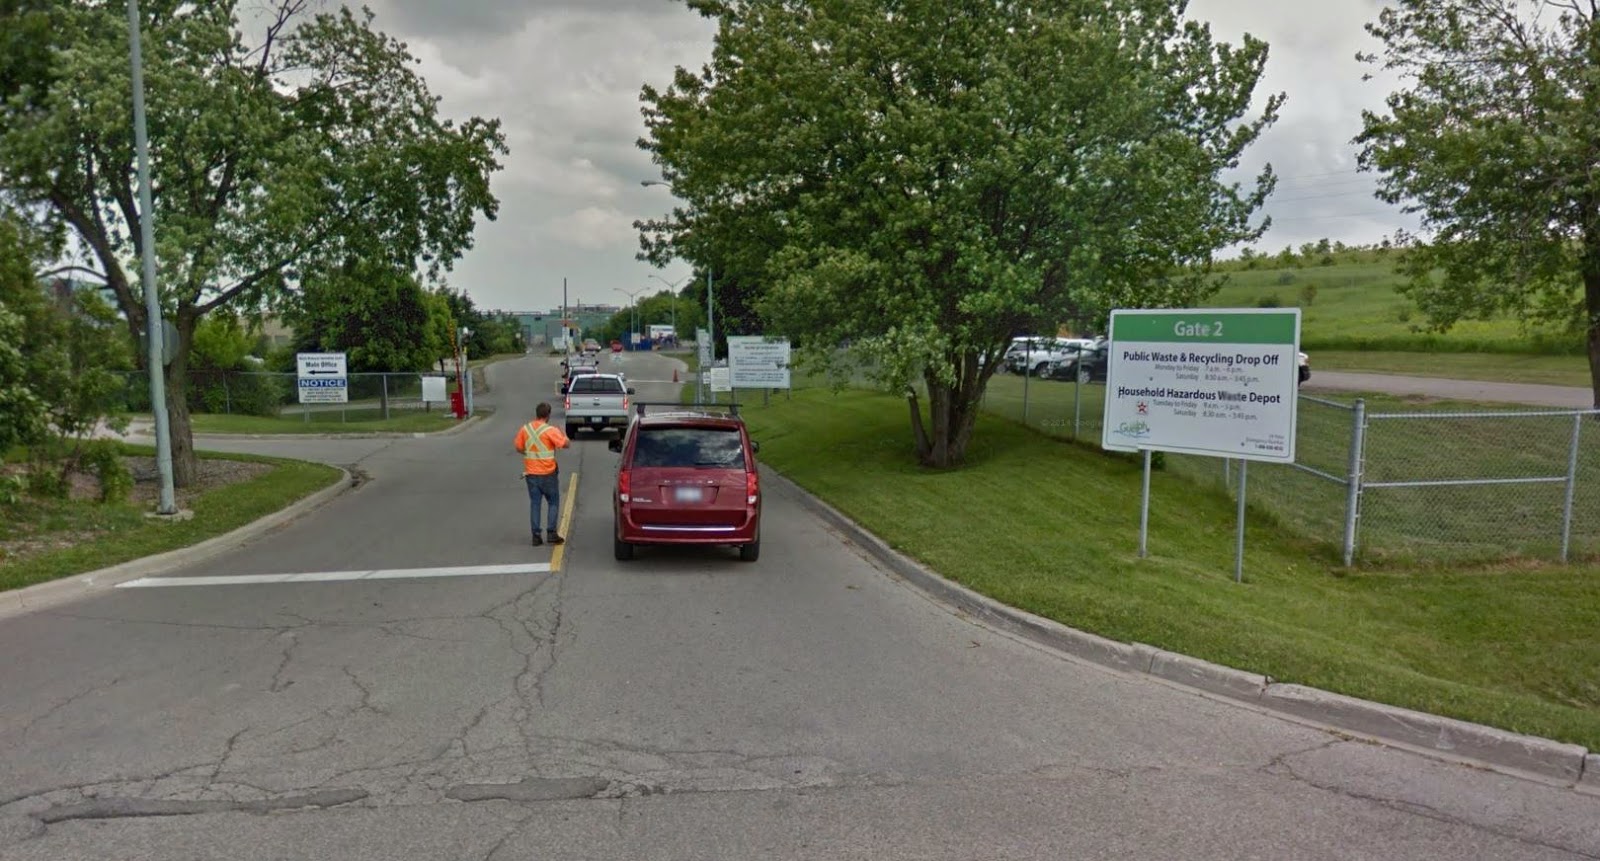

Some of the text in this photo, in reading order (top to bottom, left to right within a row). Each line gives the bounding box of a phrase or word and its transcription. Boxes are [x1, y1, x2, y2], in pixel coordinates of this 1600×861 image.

[1174, 321, 1223, 336] Gate 2
[1123, 351, 1280, 367] Public Waste & Recycling Drop Off
[1155, 364, 1175, 372] Monday
[1183, 365, 1199, 373] Friday
[1175, 373, 1199, 381] Saturday
[1118, 386, 1281, 405] Household Hazardous Waste Depot
[1153, 399, 1174, 407] Tuesday
[1182, 400, 1198, 408] Friday
[1173, 409, 1197, 417] Saturday
[1119, 421, 1148, 433] Guelph
